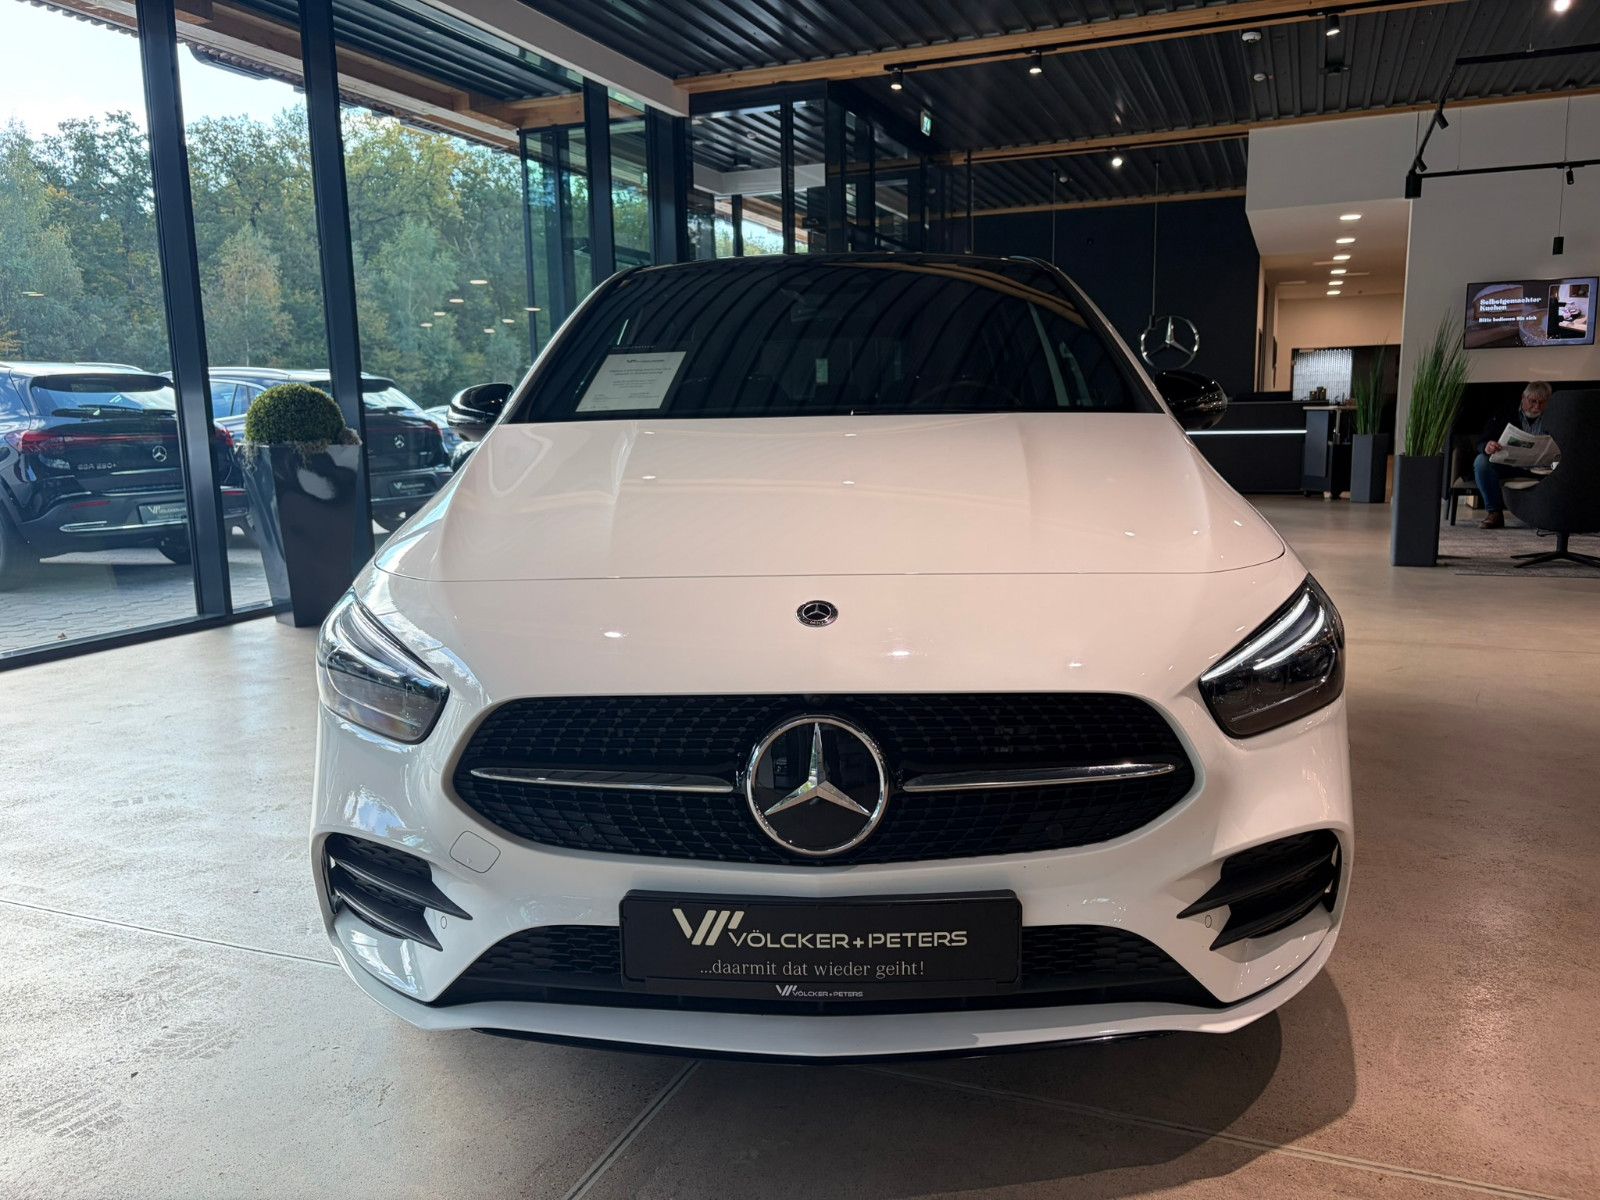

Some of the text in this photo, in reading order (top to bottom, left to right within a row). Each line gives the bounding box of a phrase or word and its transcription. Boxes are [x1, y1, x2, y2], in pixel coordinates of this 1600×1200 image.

[782, 961, 808, 976] dat
[814, 961, 871, 976] wieder
[875, 960, 925, 979] geiht!
